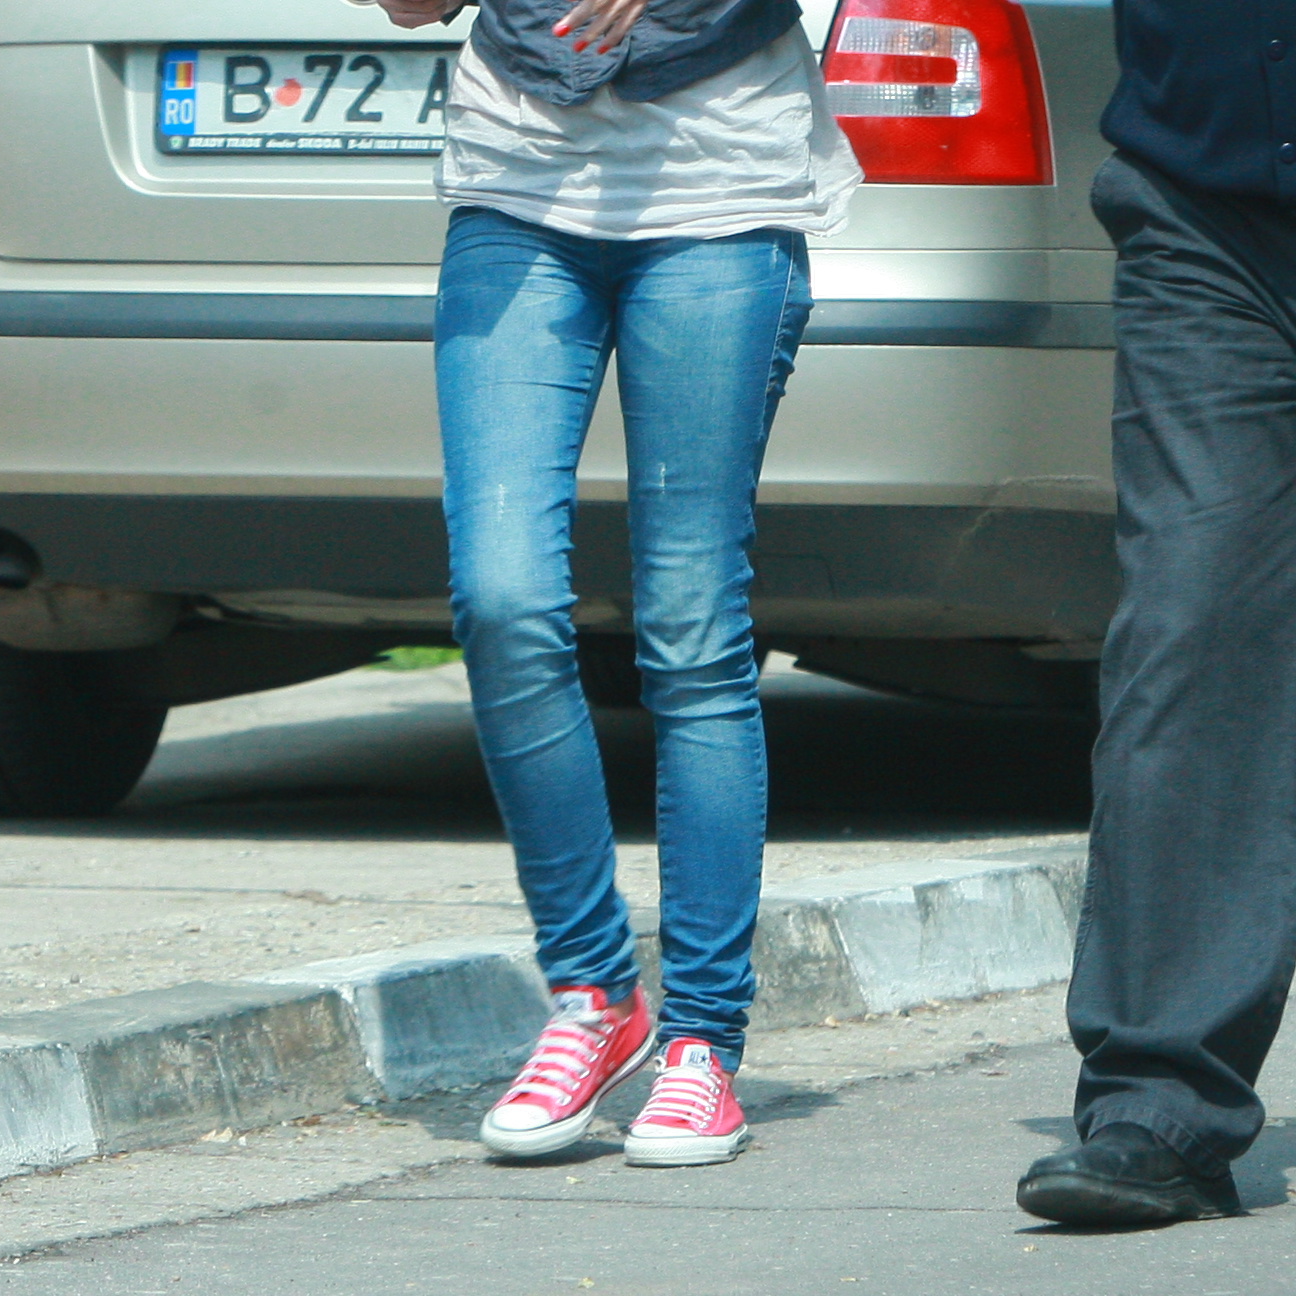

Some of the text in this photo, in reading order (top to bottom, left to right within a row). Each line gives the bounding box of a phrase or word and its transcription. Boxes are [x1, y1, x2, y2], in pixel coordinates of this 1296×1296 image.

[164, 99, 194, 126] RO
[224, 56, 272, 124] B
[302, 54, 386, 123] 72
